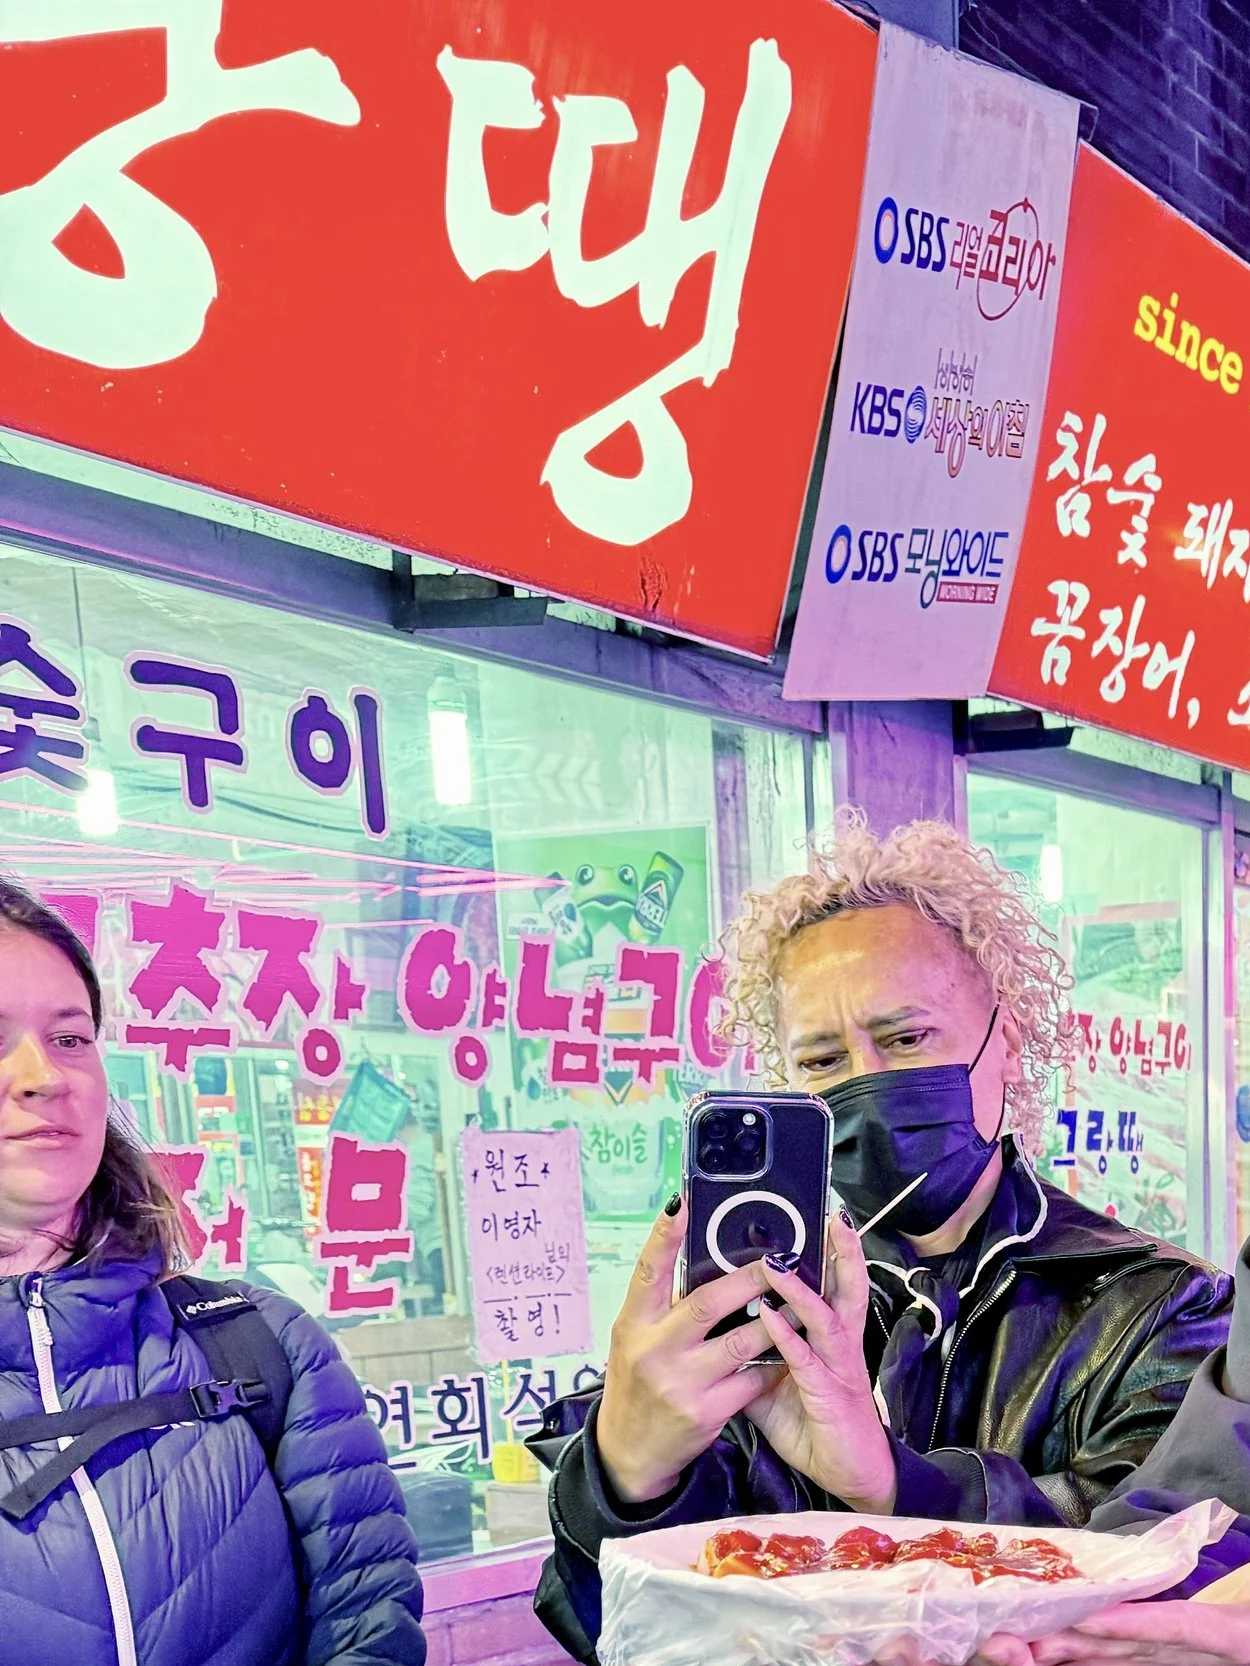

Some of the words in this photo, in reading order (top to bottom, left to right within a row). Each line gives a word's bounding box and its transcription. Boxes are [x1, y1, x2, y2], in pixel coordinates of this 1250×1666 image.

[900, 207, 950, 273] SBS
[950, 209, 1056, 301] 리얼코리아
[1133, 291, 1243, 394] since
[850, 381, 904, 438] KBS
[1047, 411, 1162, 568] 참숯
[850, 530, 904, 583] SBS
[905, 528, 1009, 609] 모닝와이드
[1031, 580, 1200, 729] 꼼장어,
[485, 1148, 540, 1193] 원조
[589, 1122, 650, 1165] 참이슬
[481, 1208, 542, 1242] 이영자
[196, 1296, 243, 1311] Columbia
